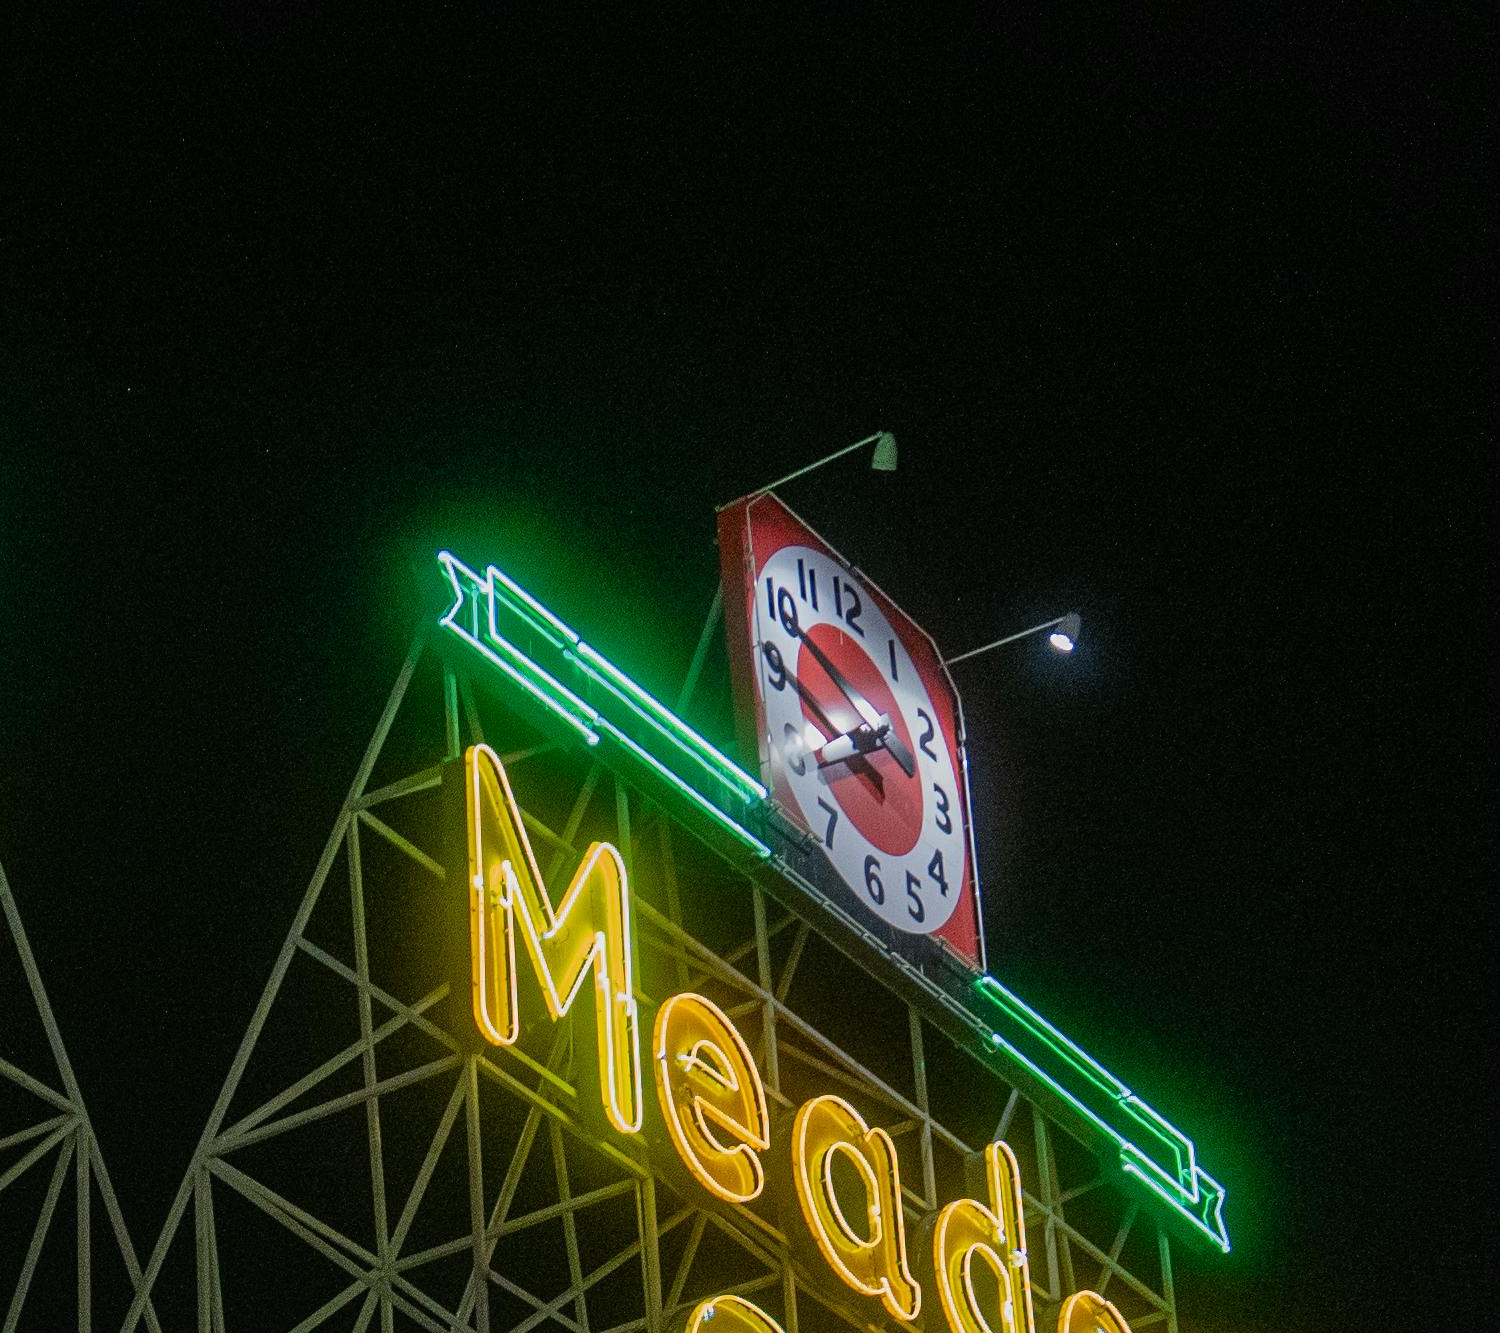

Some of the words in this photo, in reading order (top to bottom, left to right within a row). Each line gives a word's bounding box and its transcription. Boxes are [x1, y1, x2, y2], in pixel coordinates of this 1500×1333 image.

[766, 577, 799, 638] 10
[797, 558, 819, 614] 11
[833, 576, 864, 638] 12
[763, 640, 786, 692] 9
[888, 639, 898, 682] 1
[917, 707, 937, 762] 2
[817, 797, 838, 850] 7
[934, 783, 952, 836] 3
[863, 854, 885, 906] 6
[906, 870, 925, 924] 5
[928, 849, 949, 898] 4
